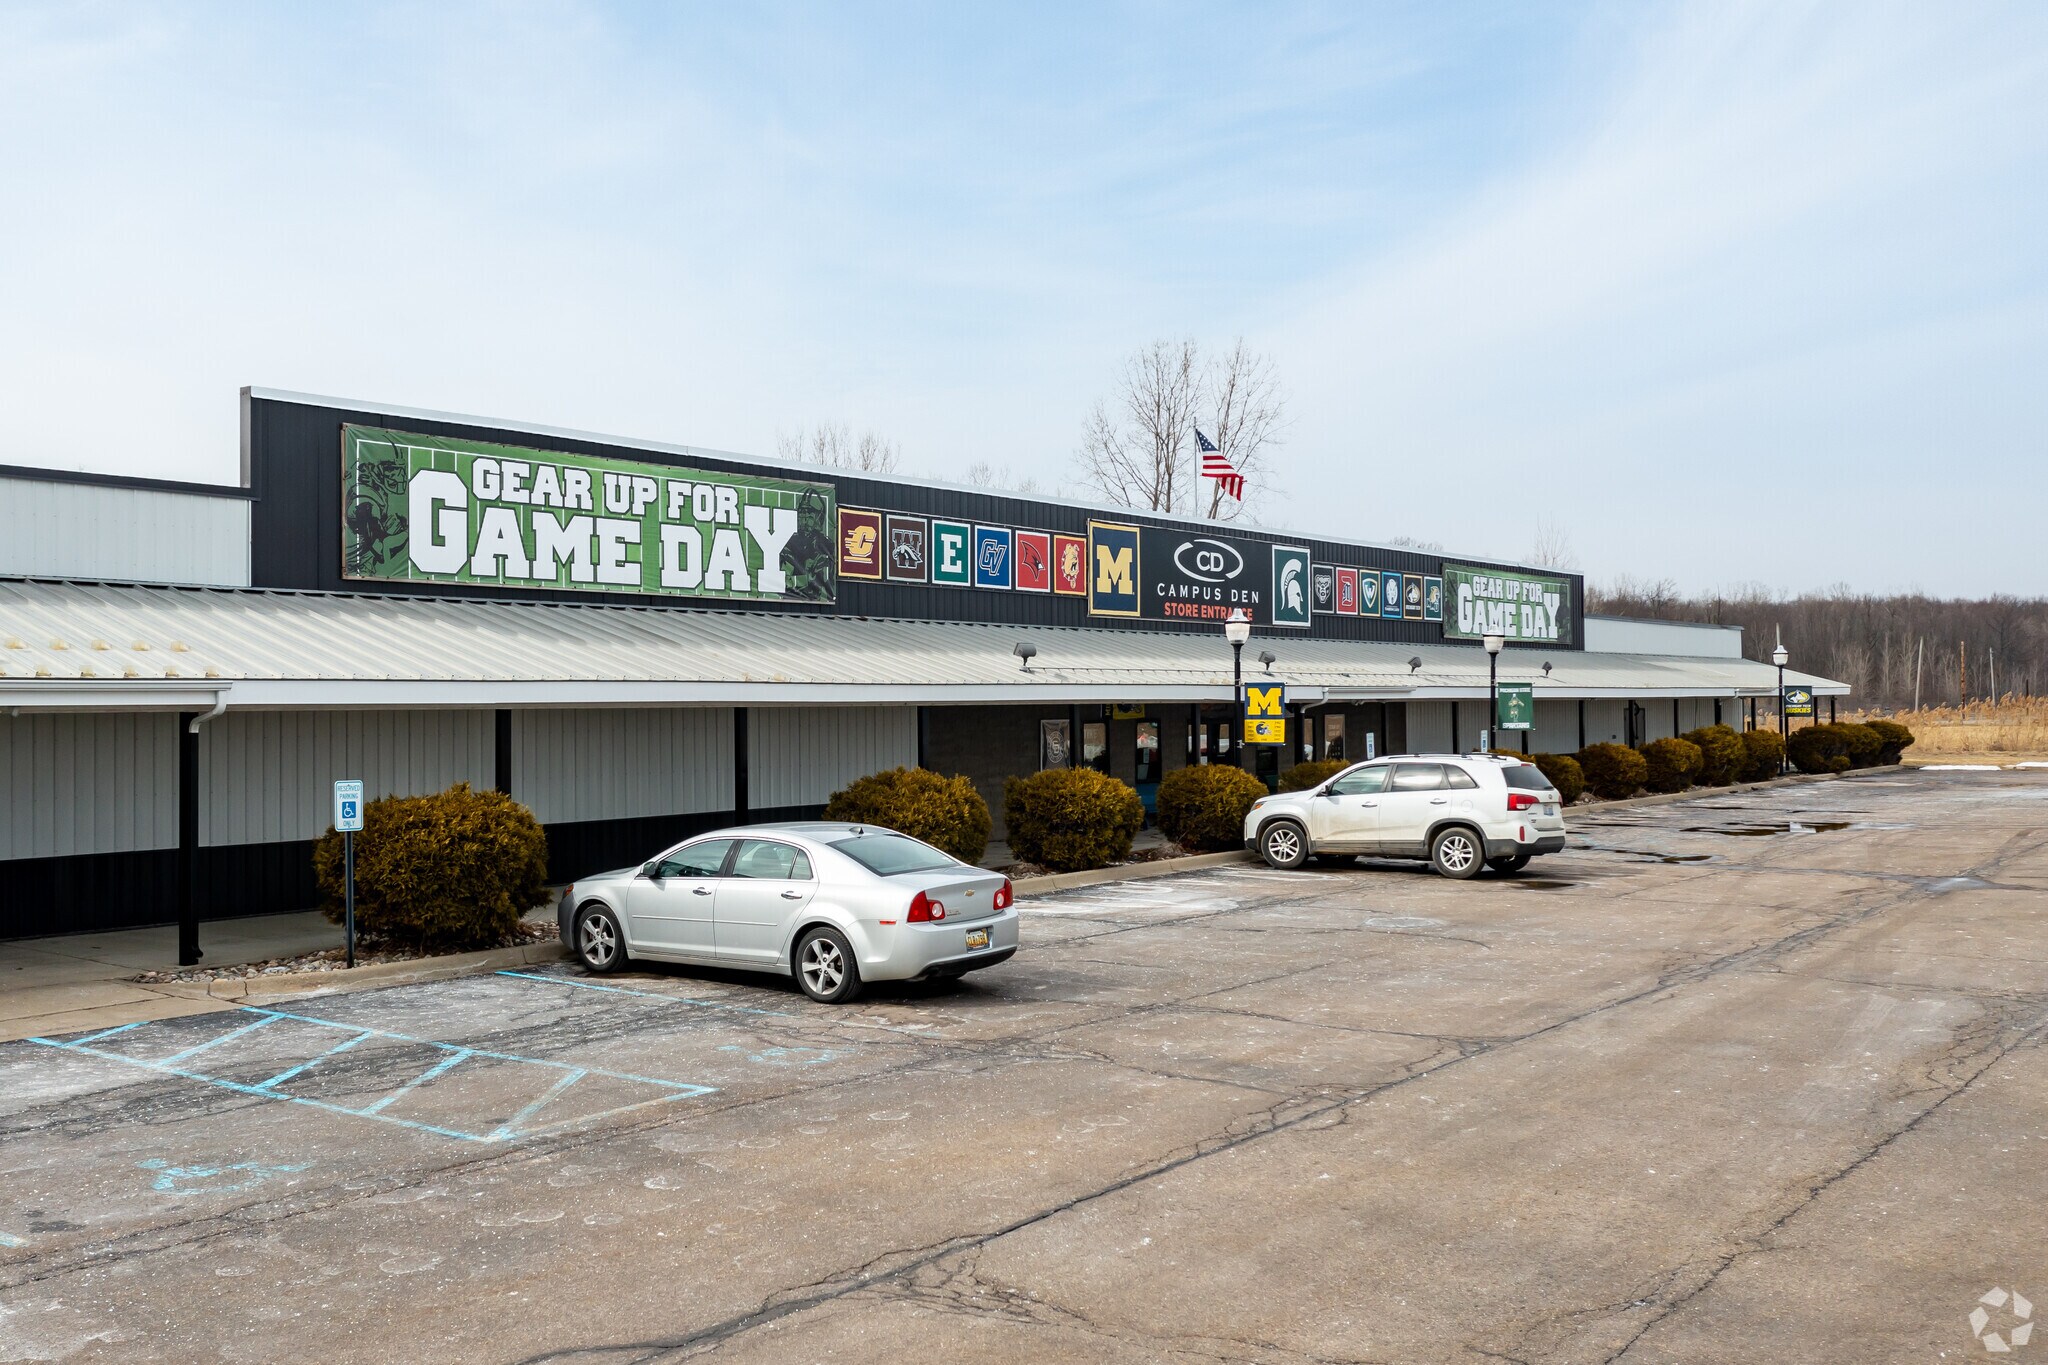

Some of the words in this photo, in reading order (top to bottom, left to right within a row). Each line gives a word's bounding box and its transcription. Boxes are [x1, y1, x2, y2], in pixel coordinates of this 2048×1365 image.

[472, 457, 593, 511] GEAR
[603, 472, 658, 516] UP
[667, 480, 740, 525] FOR
[408, 469, 642, 586] GAME
[660, 505, 798, 594] DAY
[845, 525, 877, 558] C
[941, 533, 963, 574] E
[1096, 544, 1133, 595] M
[1196, 550, 1224, 572] CD
[1157, 582, 1221, 601] CAMPUS
[1231, 589, 1259, 604] DEN
[1472, 575, 1504, 599] GEAR
[1505, 579, 1520, 601] UP
[1522, 582, 1543, 603] FOR
[1164, 602, 1199, 618] STORE
[1201, 604, 1253, 621] ENTRAE
[1457, 582, 1517, 638] GAME
[1521, 592, 1560, 639] DAY
[1247, 687, 1282, 716] M
